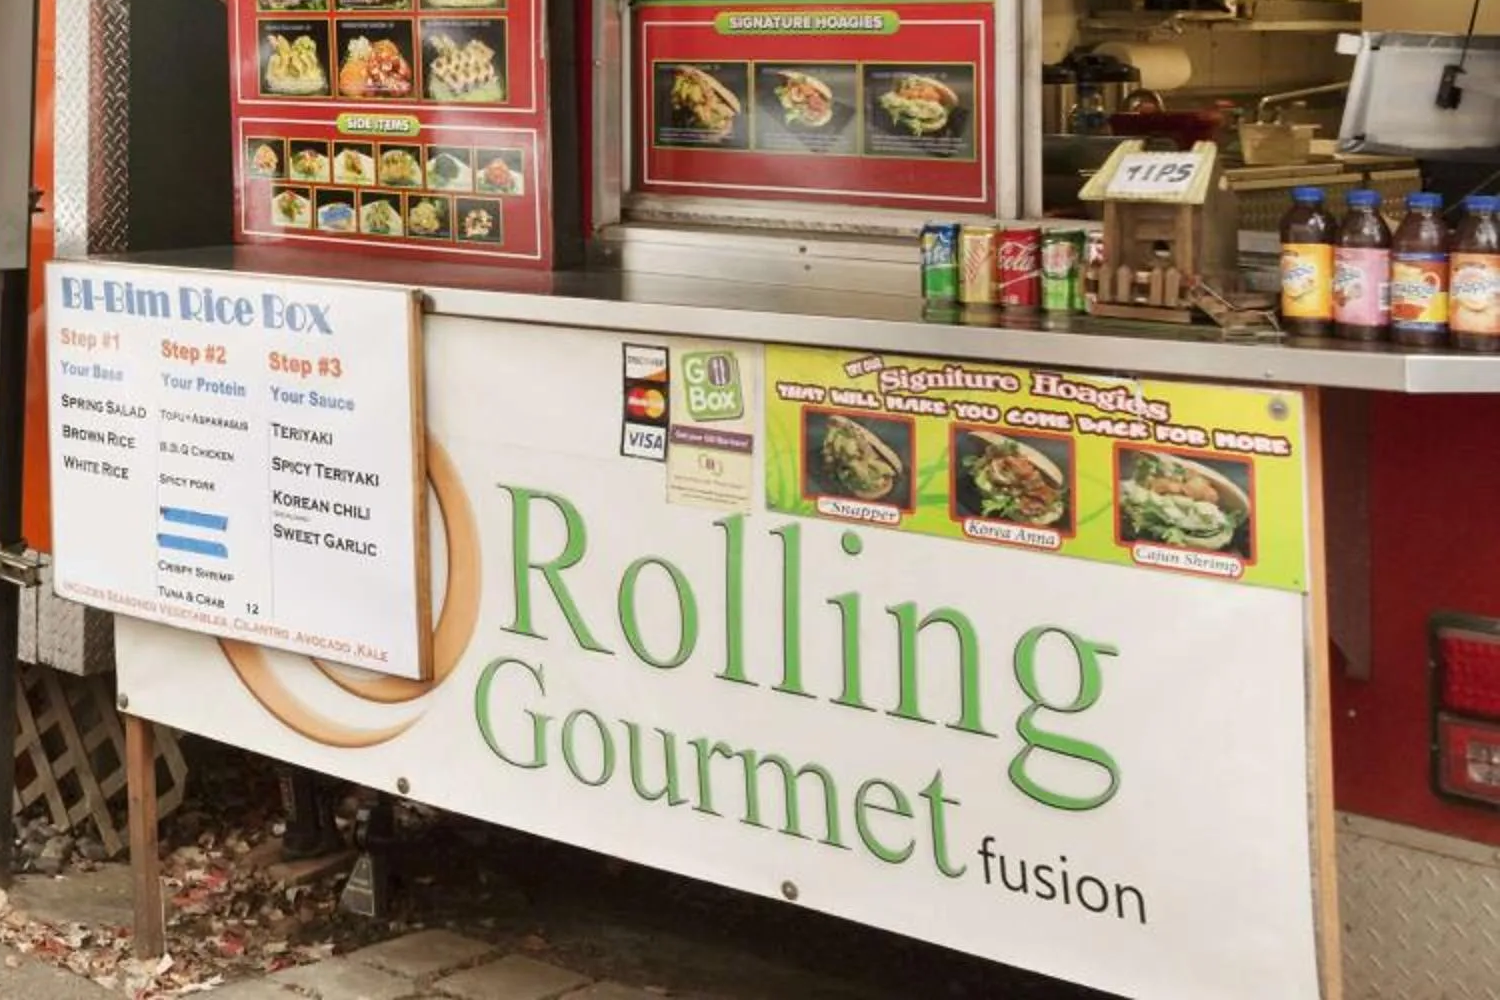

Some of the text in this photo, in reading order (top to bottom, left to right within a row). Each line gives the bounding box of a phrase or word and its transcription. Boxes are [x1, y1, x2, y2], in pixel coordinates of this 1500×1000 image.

[729, 16, 884, 30] SIGNATURE HOAGIES
[347, 117, 410, 132] SIDE ITEMS
[1127, 163, 1194, 183] TIPS
[179, 286, 254, 327] Rice
[262, 293, 333, 335] Box
[60, 327, 120, 350] Step #1
[161, 339, 227, 365] Step #2
[268, 351, 342, 378] Step #3
[60, 359, 89, 376] Your
[161, 372, 246, 397] Your Protein
[1030, 371, 1169, 421] Hoagies
[61, 393, 147, 419] SPRING SALAD
[270, 386, 355, 411] Your Sauce
[777, 383, 1290, 455] THAT WILL MAKE YOU COME BACK FOR MORE
[62, 424, 135, 449] BROWN RICE
[271, 422, 333, 446] TERIYAKI
[629, 431, 663, 450] VISA
[63, 455, 129, 480] WHITE RICE
[272, 456, 379, 487] SPICY TERIYAKI
[273, 490, 330, 513] KOREAN
[333, 503, 371, 521] CHILI
[273, 523, 377, 557] SWEET GARLIC
[1015, 529, 1057, 548] Anna
[1135, 546, 1239, 576] Cajun Shrimp
[246, 603, 260, 615] 12
[498, 483, 1120, 812] Rolling
[474, 655, 967, 879] Gourmet
[977, 837, 1147, 925] fusion
